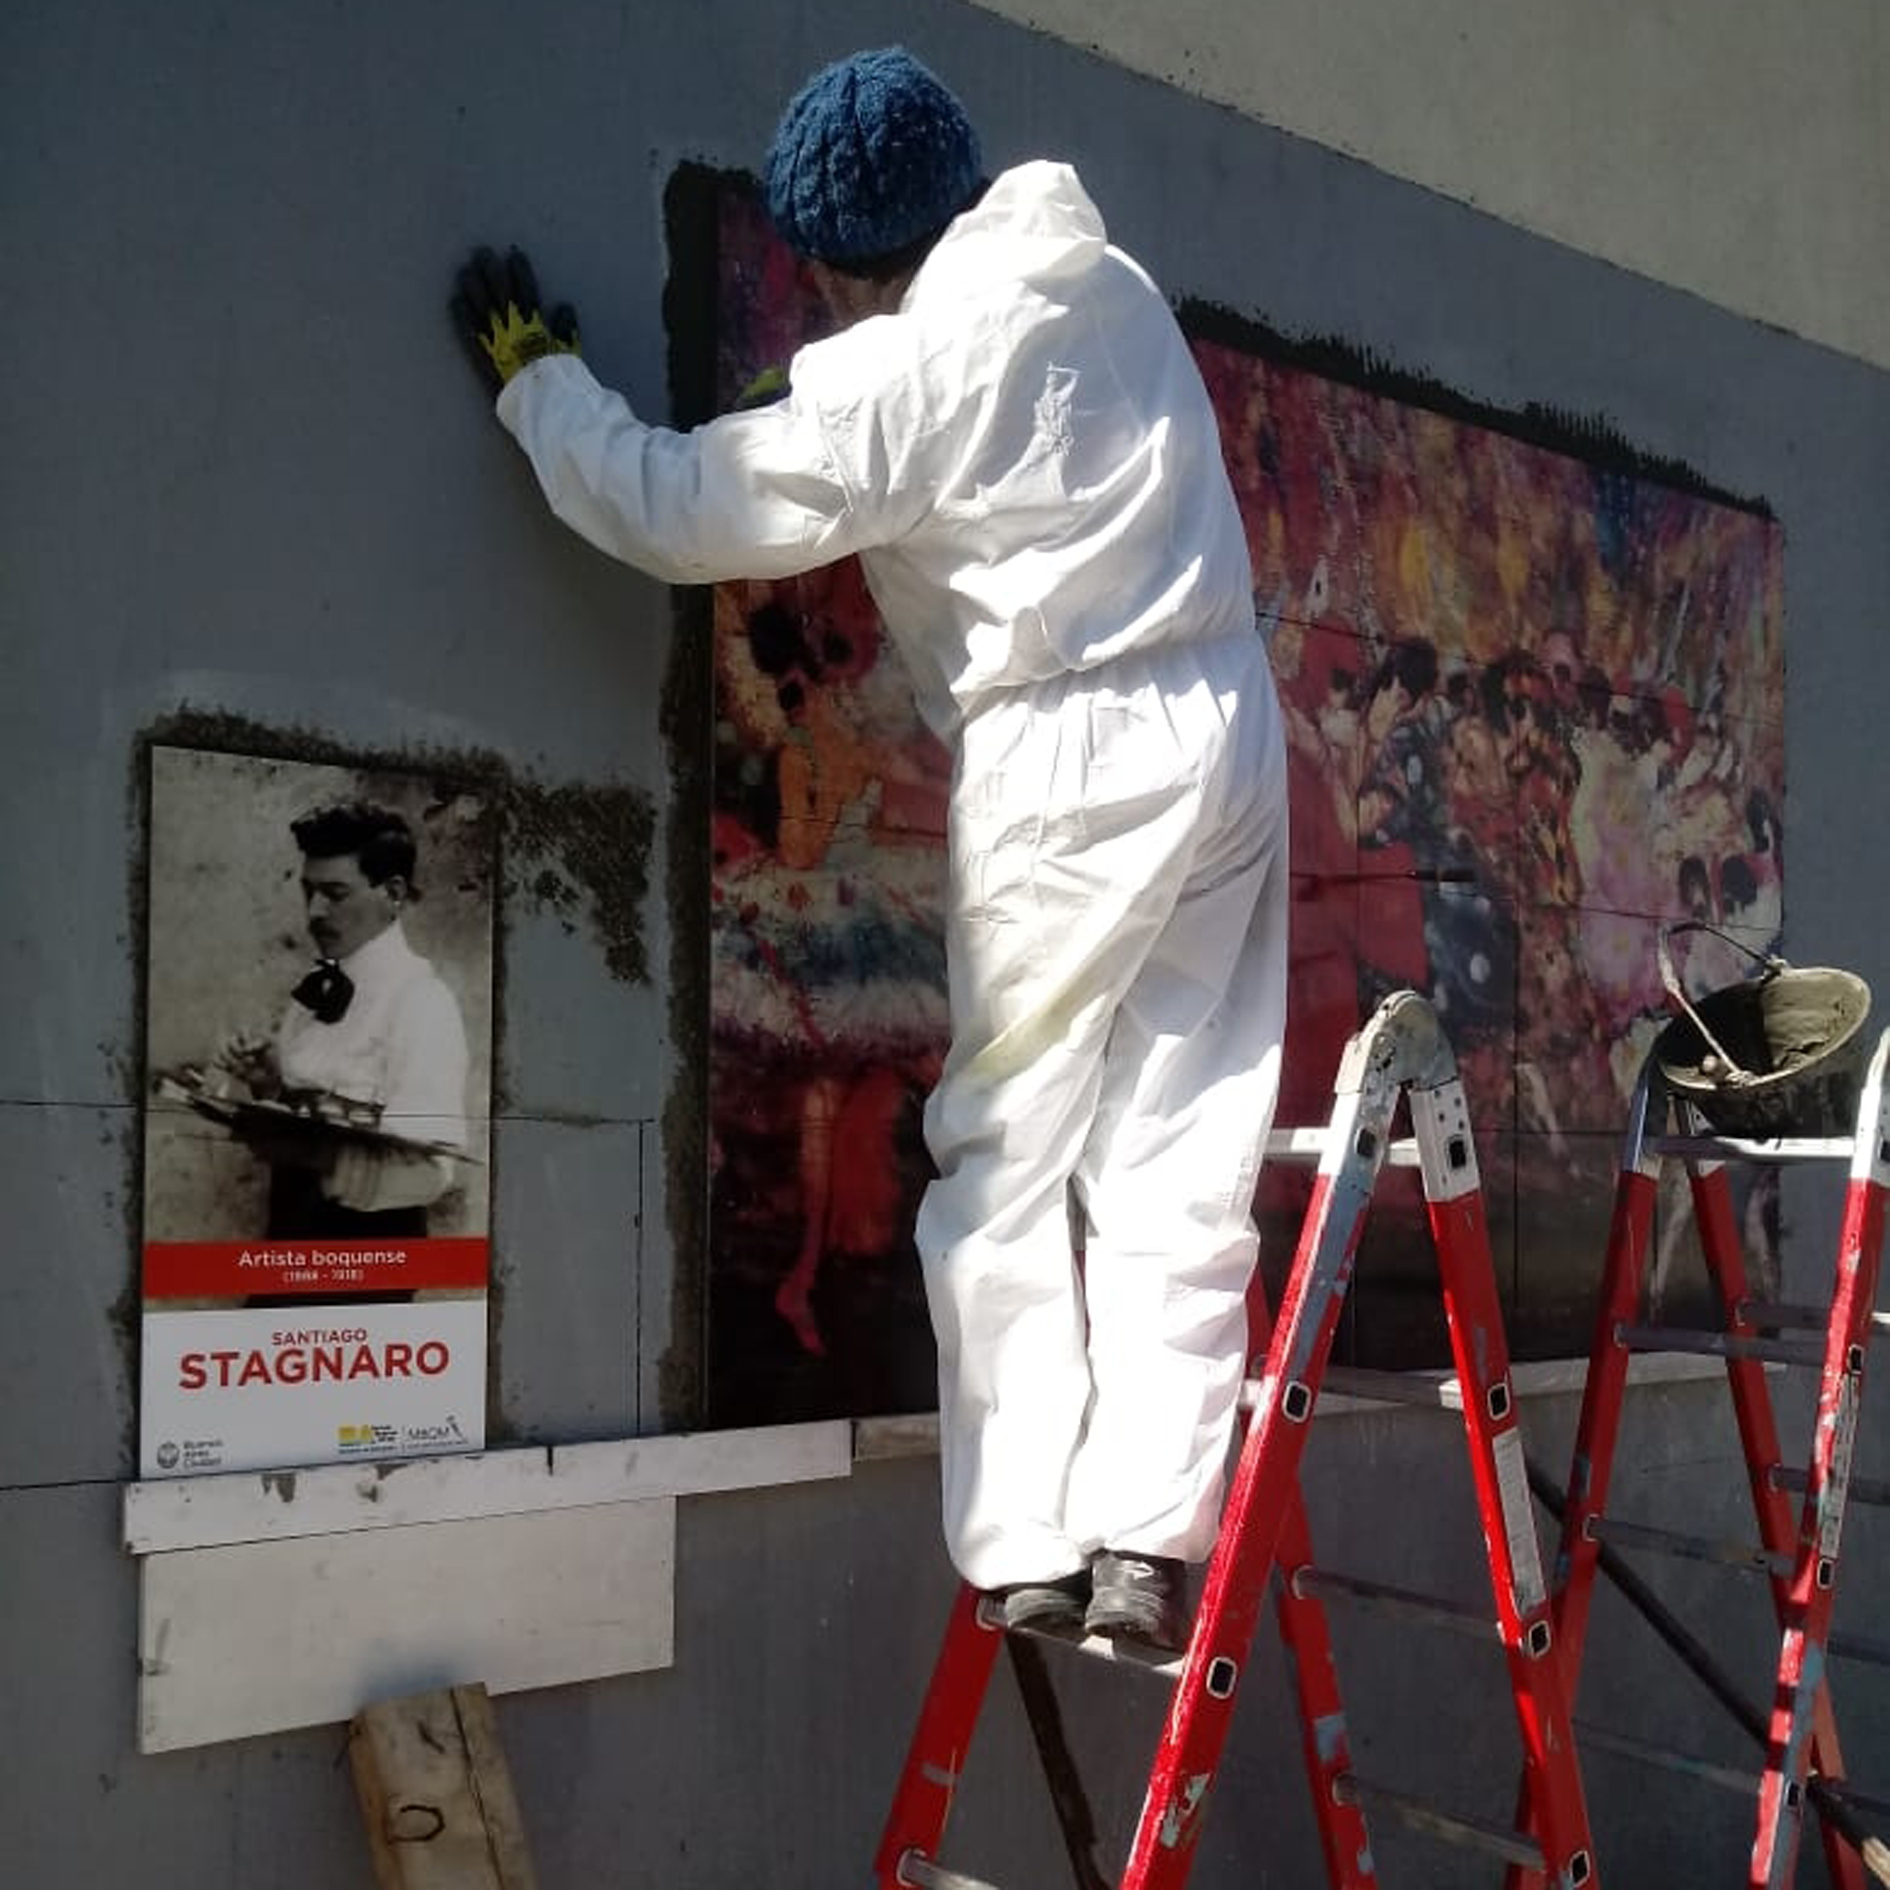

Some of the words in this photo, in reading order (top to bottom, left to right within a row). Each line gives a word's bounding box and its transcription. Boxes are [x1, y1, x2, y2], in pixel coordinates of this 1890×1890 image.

[239, 1251, 306, 1266] Artista
[312, 1250, 407, 1267] boquense
[272, 1328, 367, 1346] SANTIAGO
[179, 1341, 450, 1389] STAGNARO
